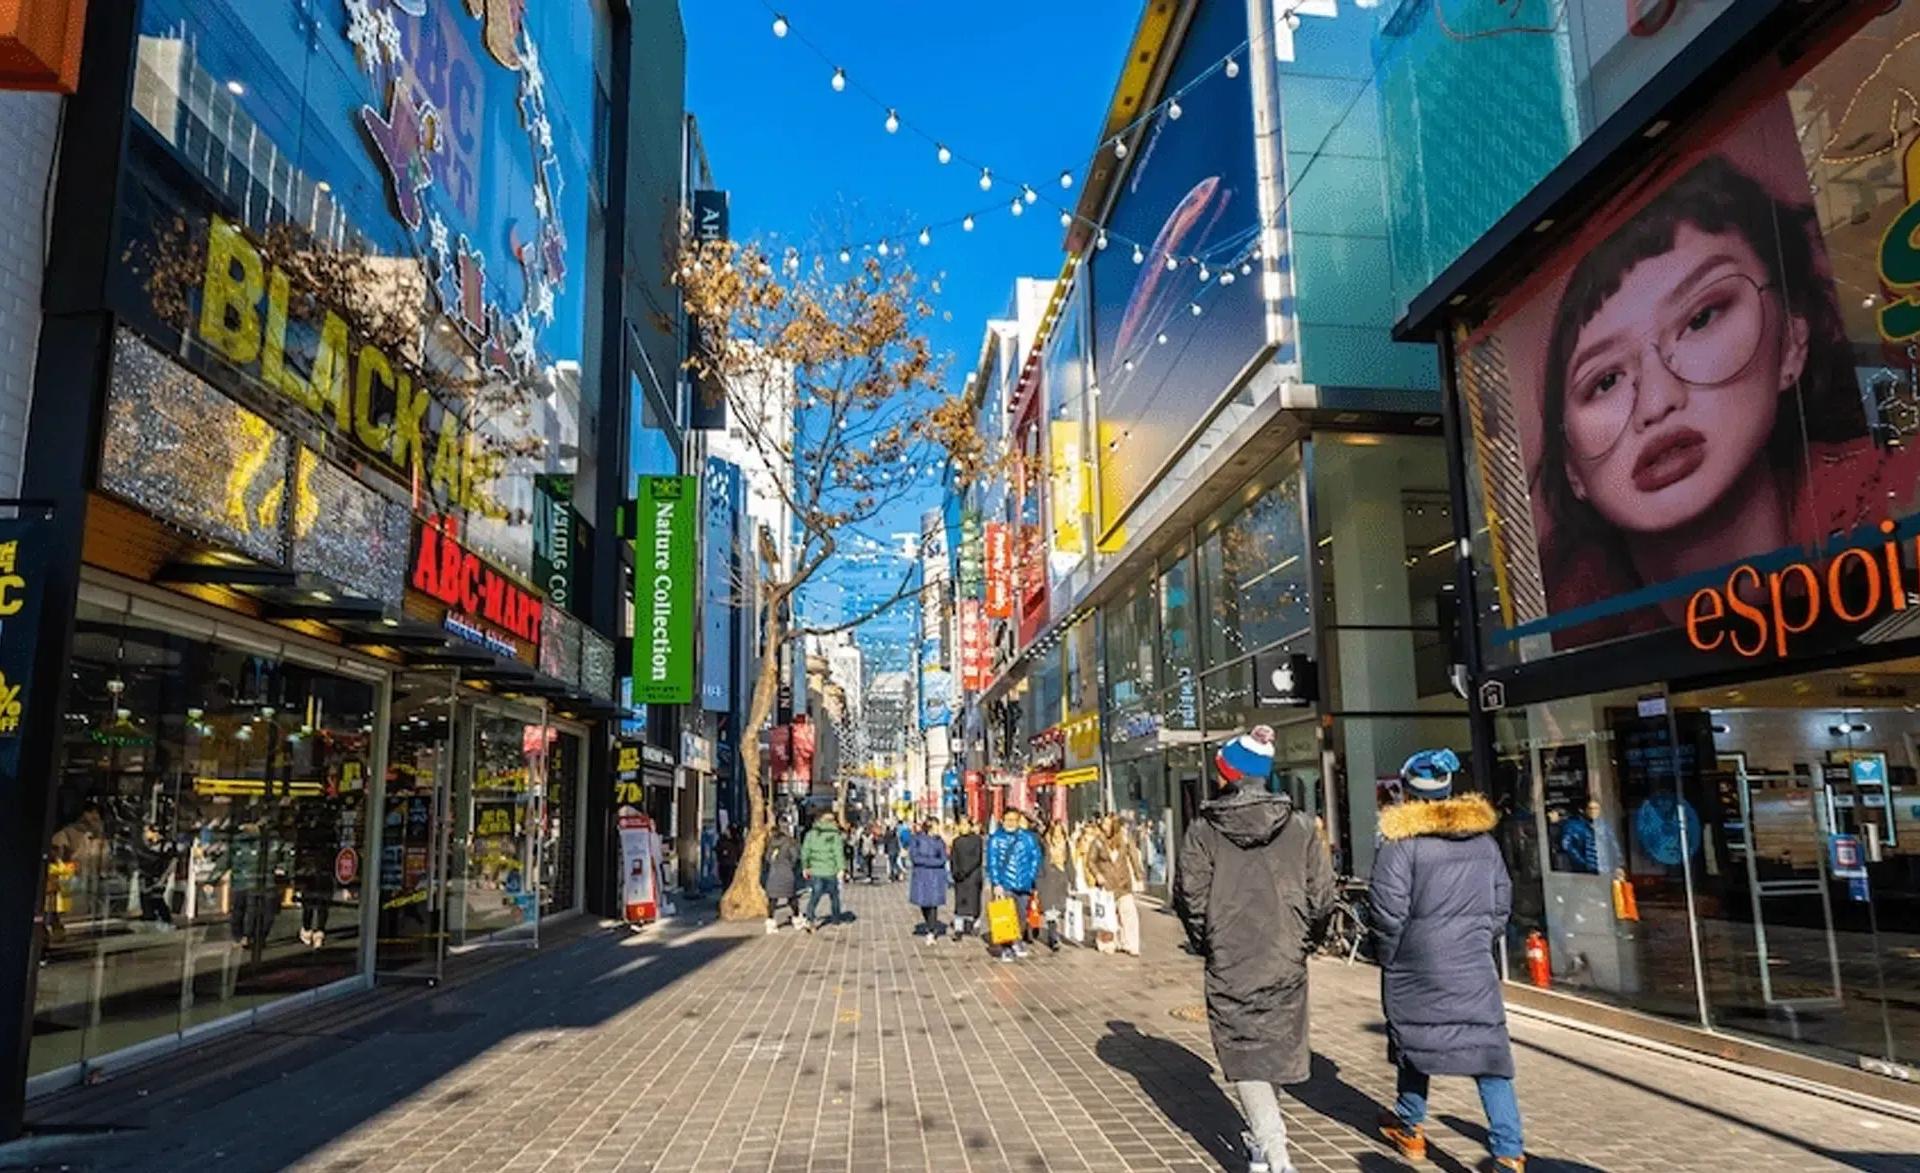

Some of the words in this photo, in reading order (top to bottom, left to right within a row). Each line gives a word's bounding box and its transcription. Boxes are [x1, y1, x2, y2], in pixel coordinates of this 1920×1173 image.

[200, 213, 431, 478] BLACK
[412, 518, 543, 645] ABC-MART
[655, 501, 675, 571] Nature
[1686, 518, 1920, 657] espoi
[652, 574, 673, 681] Collection
